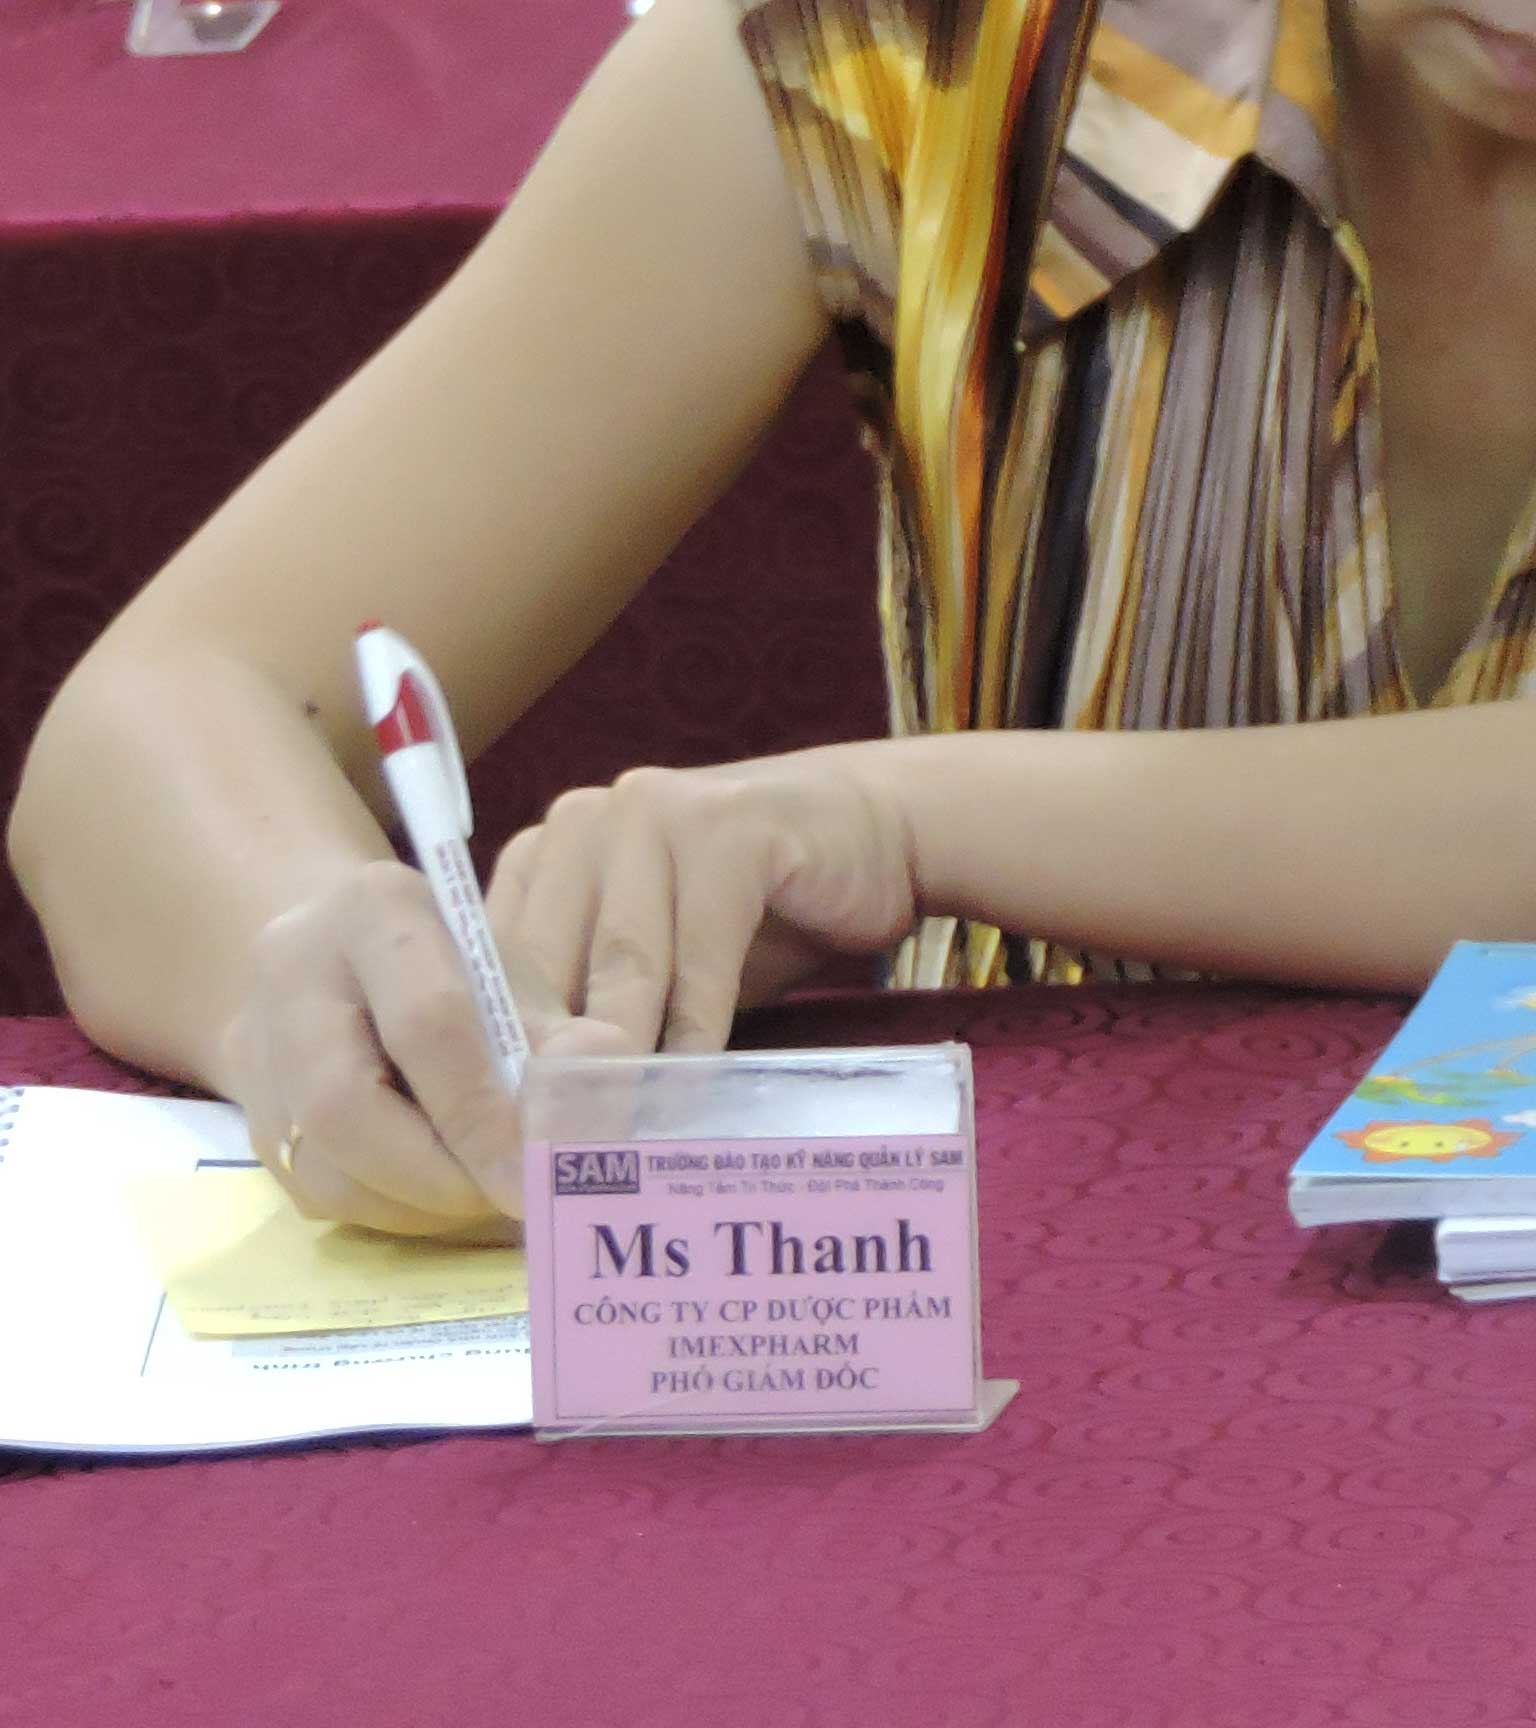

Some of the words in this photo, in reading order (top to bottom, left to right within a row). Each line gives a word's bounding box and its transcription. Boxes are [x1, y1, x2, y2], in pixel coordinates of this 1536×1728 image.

[557, 1152, 639, 1185] SAM
[589, 1223, 691, 1279] Ms
[713, 1217, 933, 1276] Thanh
[671, 1301, 708, 1324] TY
[719, 1299, 758, 1323] CP
[668, 1333, 860, 1360] IMEXPHARM
